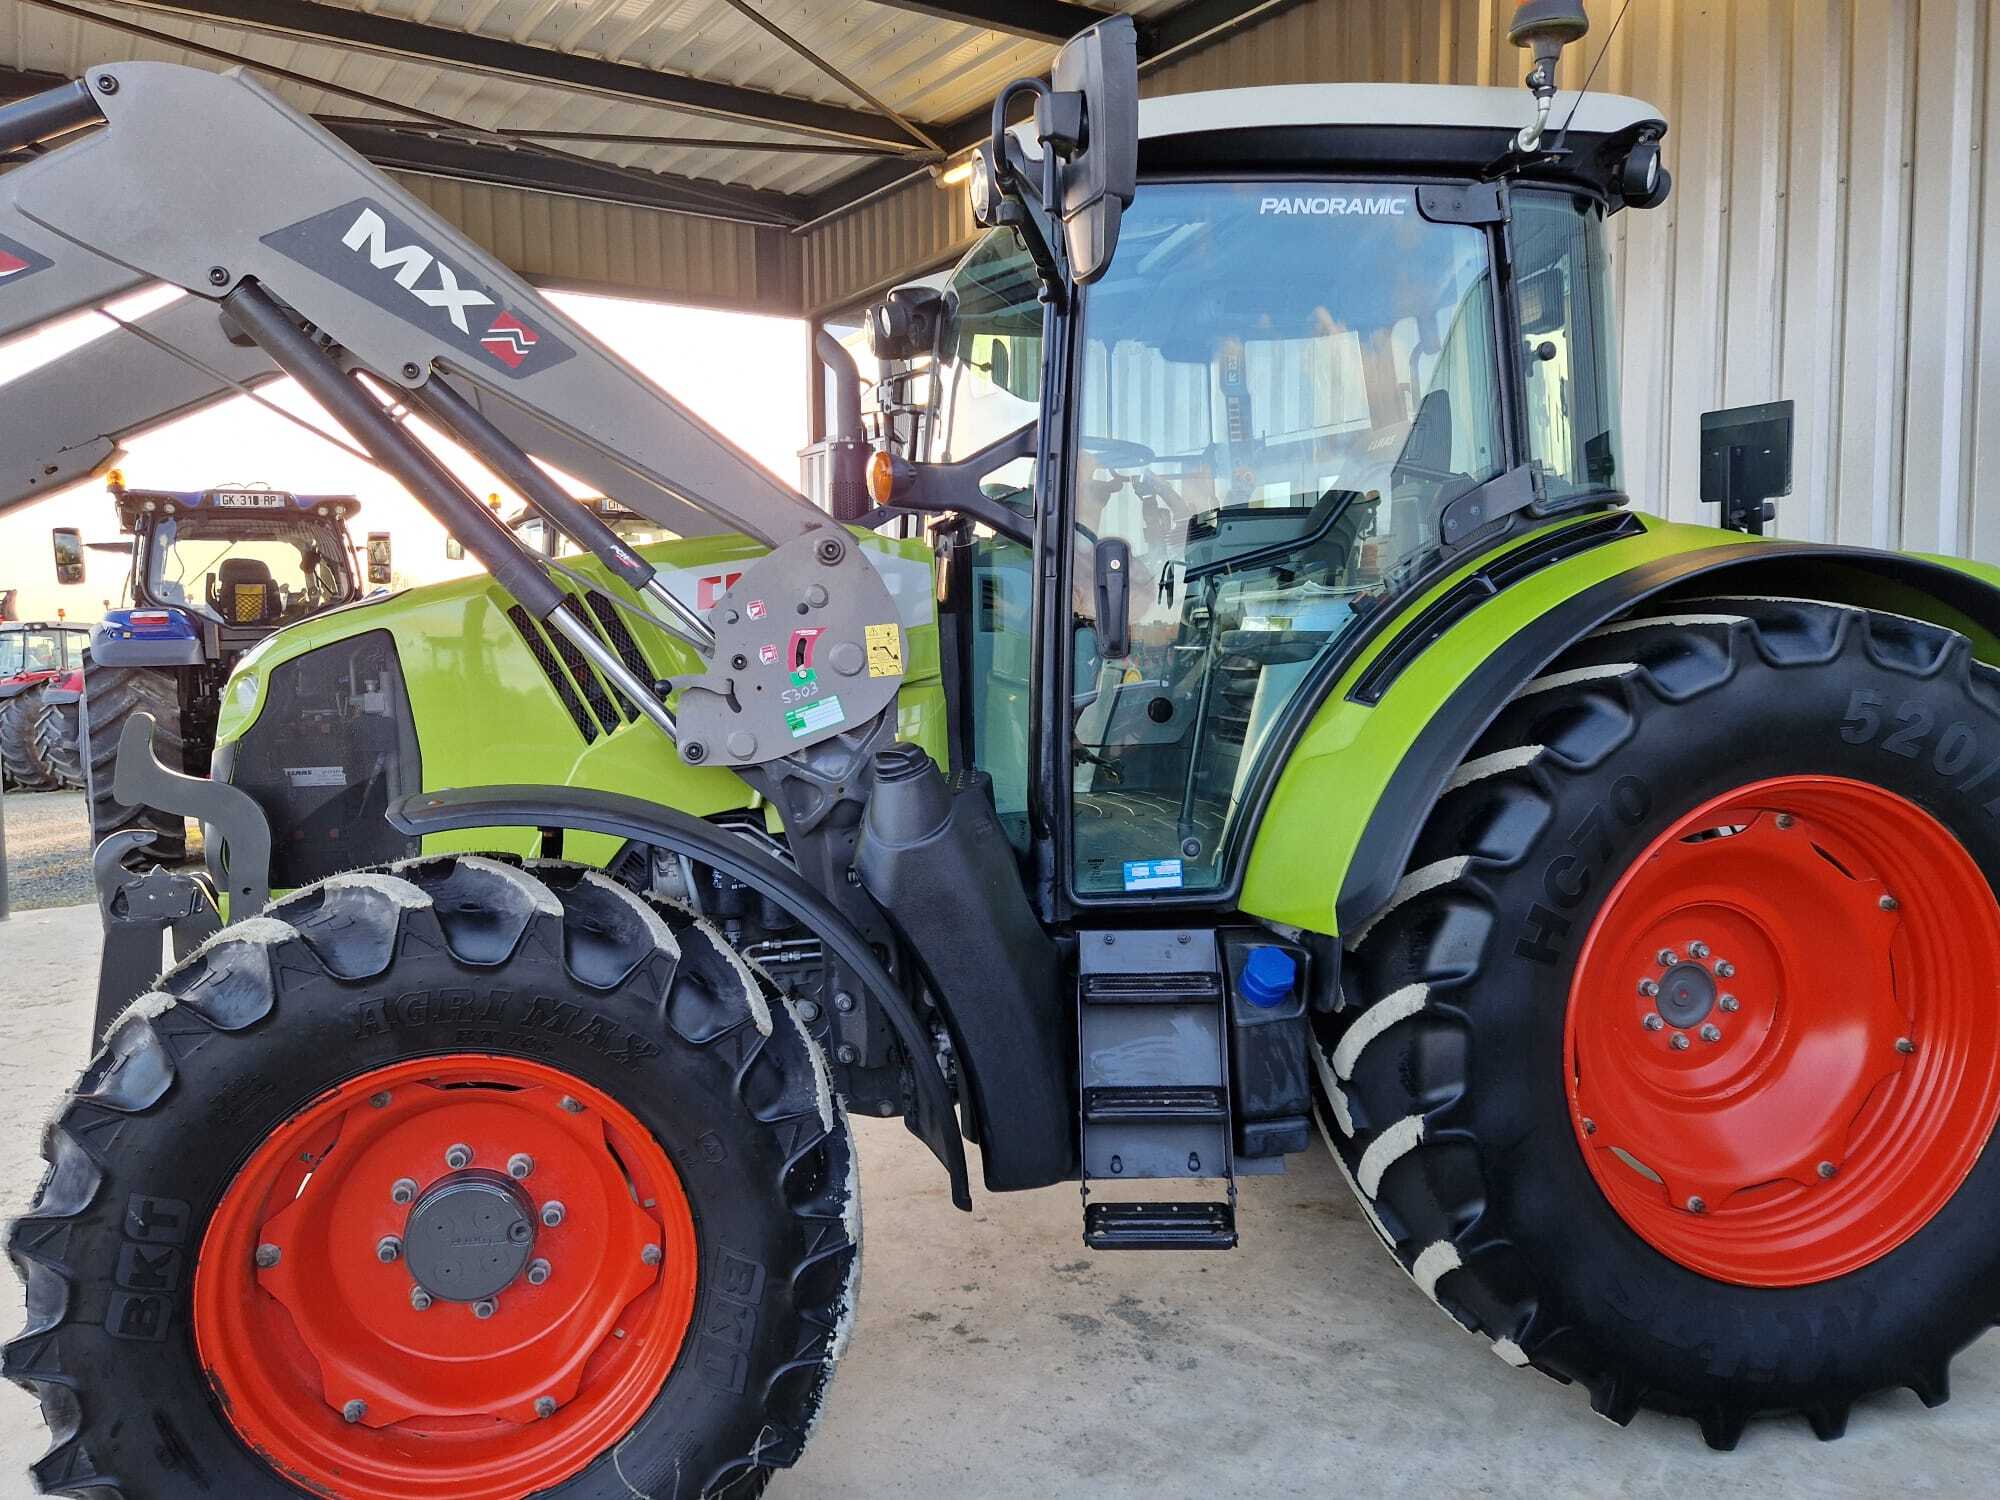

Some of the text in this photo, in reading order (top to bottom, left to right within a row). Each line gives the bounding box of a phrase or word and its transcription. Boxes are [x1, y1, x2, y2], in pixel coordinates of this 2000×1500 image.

[1260, 197, 1407, 215] PANORAMIC
[341, 207, 496, 336] MX
[353, 988, 661, 1073] AGRI MAX
[116, 1197, 184, 1337] BKT
